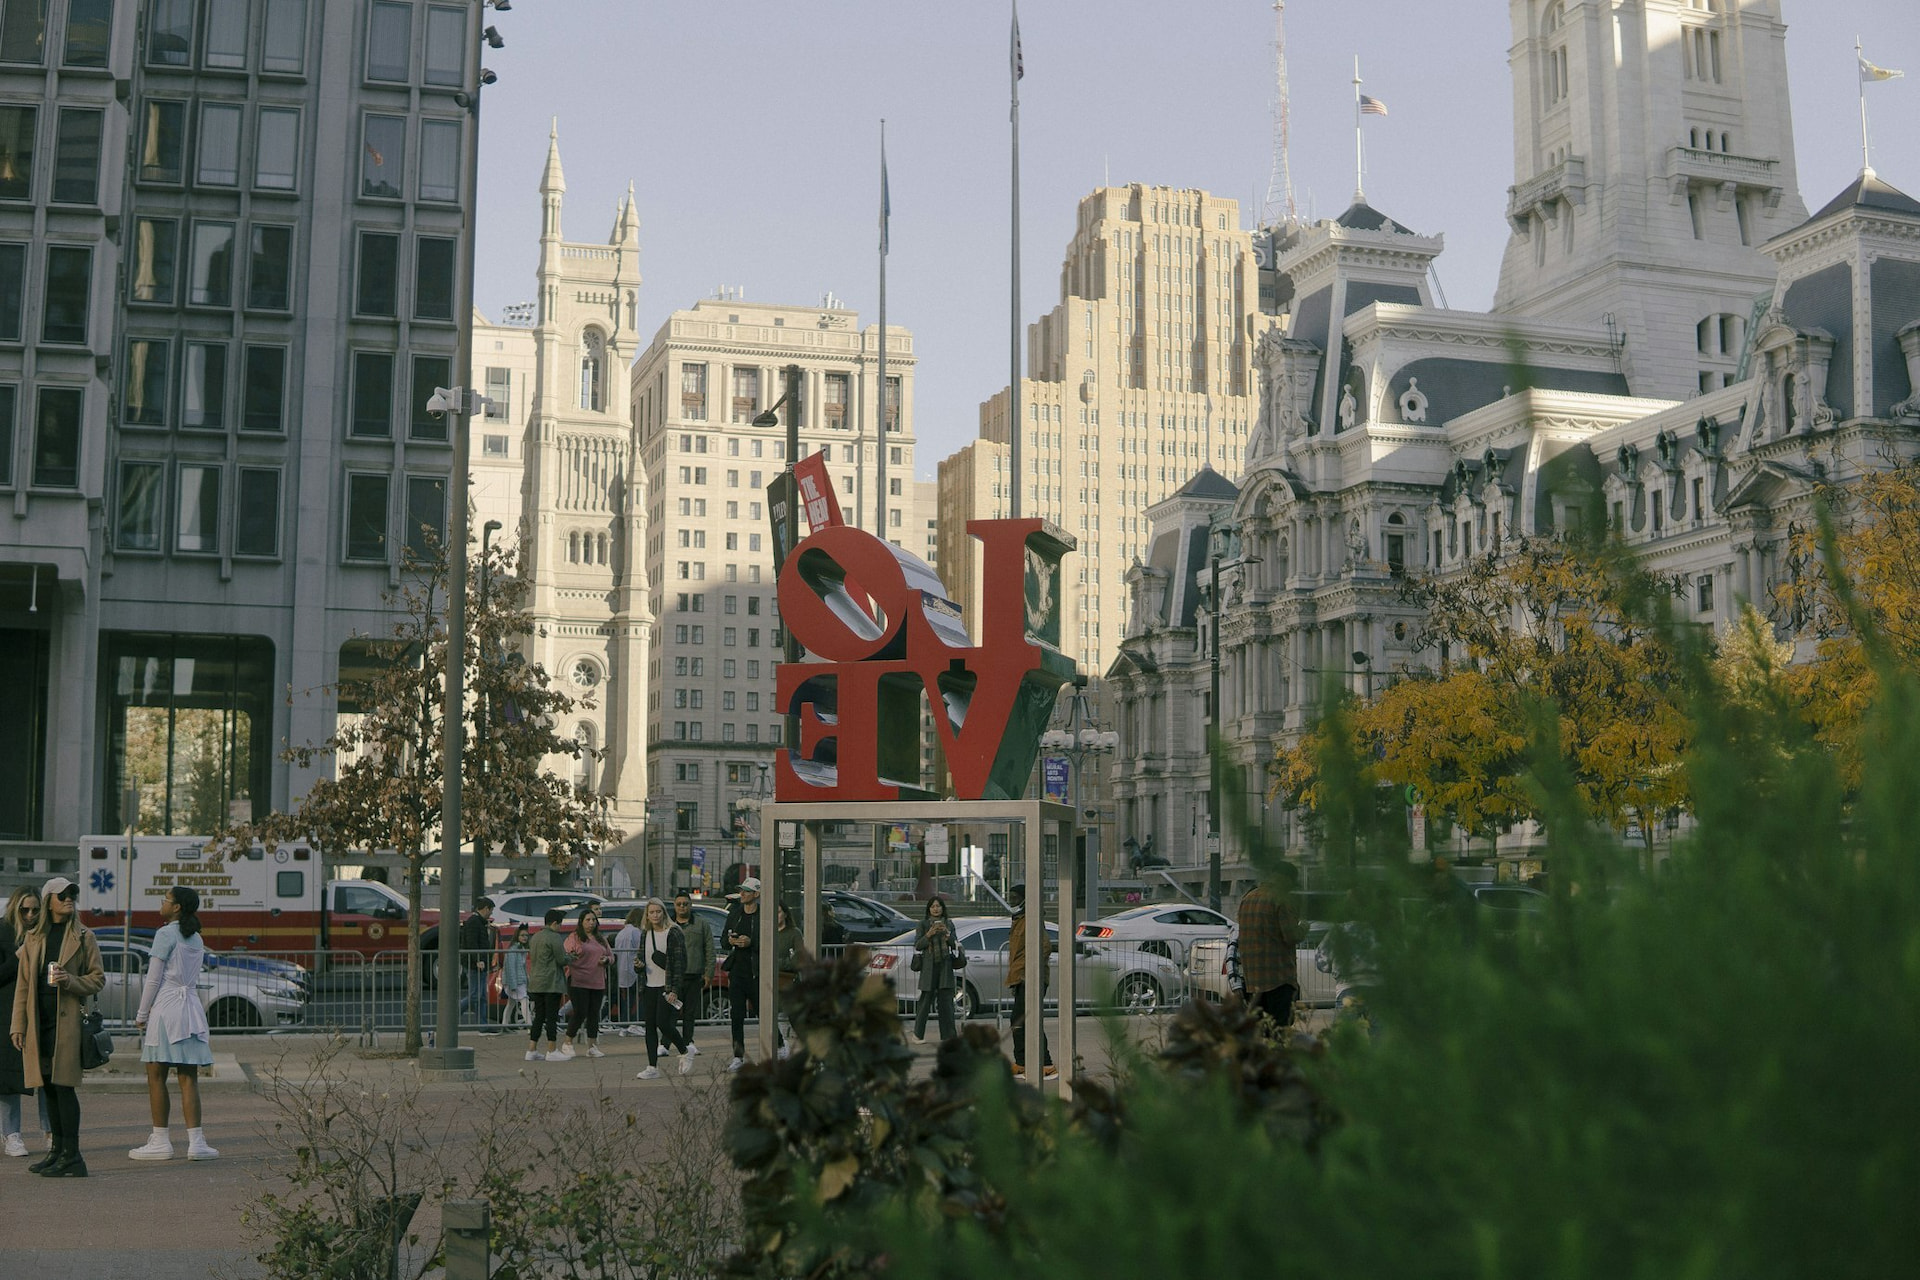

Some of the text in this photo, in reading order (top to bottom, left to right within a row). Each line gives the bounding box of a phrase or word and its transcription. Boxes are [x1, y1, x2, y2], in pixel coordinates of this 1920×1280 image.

[801, 475, 820, 501] THE
[160, 862, 225, 873] PHILADELPHIA
[153, 875, 232, 886] FIRE DEPARTMENT
